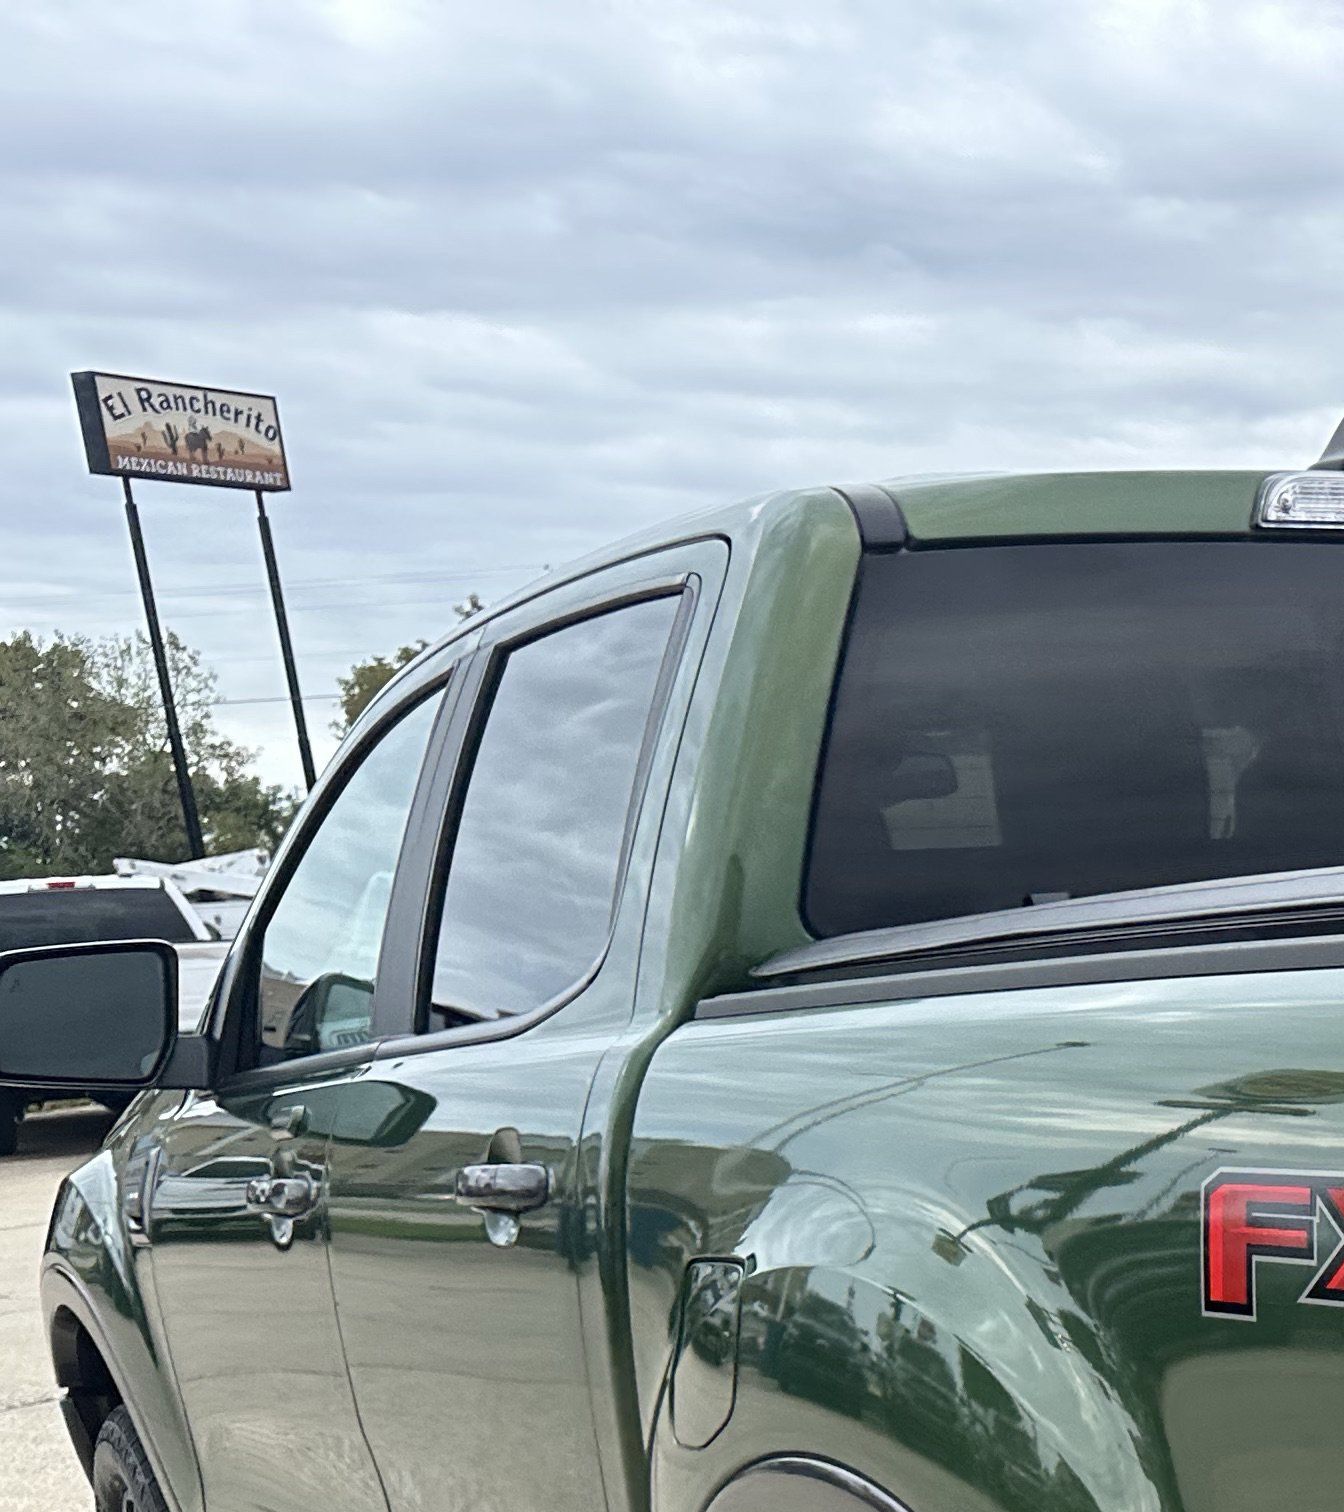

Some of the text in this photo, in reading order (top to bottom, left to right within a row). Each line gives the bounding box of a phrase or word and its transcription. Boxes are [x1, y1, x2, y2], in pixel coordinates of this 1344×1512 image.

[101, 386, 279, 442] El Rancherito
[117, 455, 284, 487] MEXICAN RESTAURANT
